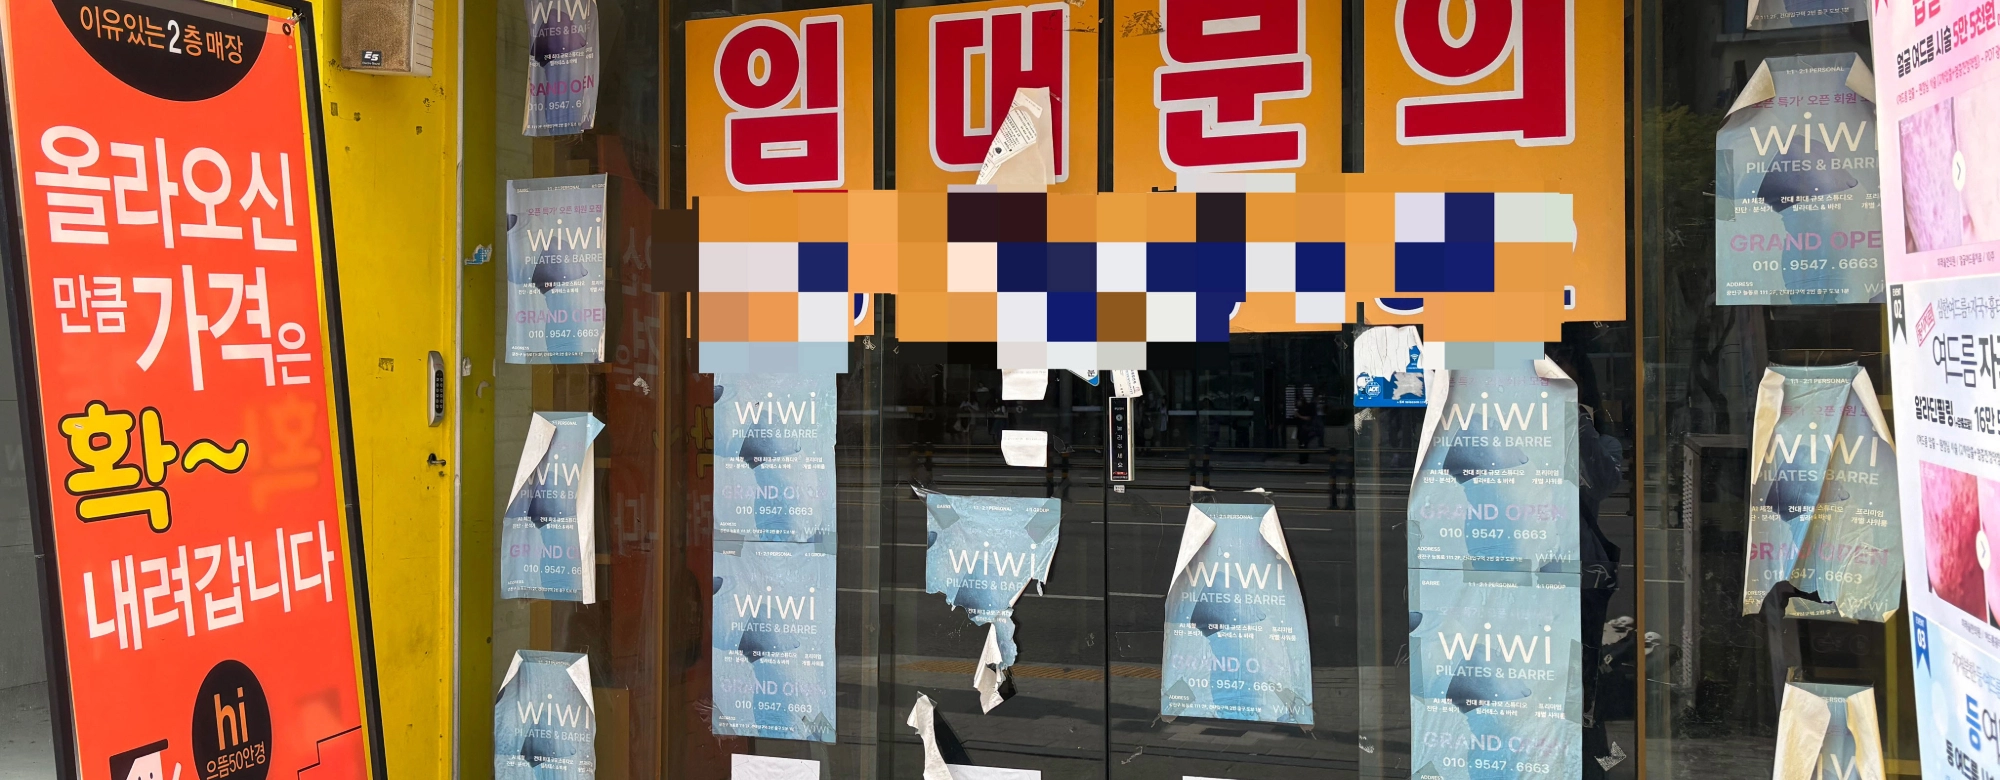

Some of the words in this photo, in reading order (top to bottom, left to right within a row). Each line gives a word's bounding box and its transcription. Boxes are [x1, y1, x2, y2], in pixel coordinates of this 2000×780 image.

[80, 5, 166, 49] 이유있는
[207, 33, 243, 65] 매장
[563, 26, 570, 35] &
[1896, 48, 1912, 78] 얼굴
[1911, 34, 1935, 69] 여드름
[1936, 25, 1952, 56] 시술
[1952, 15, 1968, 48] 5만
[1969, 0, 1997, 39] 5천원
[1809, 66, 1845, 74] PERSONAL
[549, 101, 570, 110] 9547
[1807, 94, 1830, 106] 오픈
[1834, 92, 1857, 104] 회원
[1746, 159, 1811, 174] PILATES
[1815, 159, 1826, 171] &
[35, 125, 297, 252] 올라오신
[1826, 194, 1853, 202] 스튜디오
[1734, 206, 1747, 214] 진단
[1753, 205, 1773, 213] 분석기
[527, 217, 601, 252] wiwi
[1730, 232, 1822, 252] GRAND
[525, 254, 562, 265] PILATES
[564, 254, 570, 263] &
[572, 253, 603, 263] BARRE
[1753, 260, 1779, 271] 010
[1790, 259, 1828, 271] 9547
[1838, 257, 1879, 270] 6663
[515, 309, 568, 324] GRAND
[1893, 299, 1903, 319] 02
[53, 275, 127, 333] 만큼
[133, 265, 312, 391] 가격은
[529, 330, 544, 339] 010
[550, 329, 571, 338] 9547
[577, 328, 599, 338] 6663
[1932, 333, 1978, 387] 여드름
[734, 391, 816, 425] wiwi
[1441, 391, 1548, 431] wiwi
[1974, 406, 1996, 435] 16만
[732, 429, 772, 438] PILATES
[775, 429, 782, 438] &
[784, 428, 818, 438] BARRE
[1433, 436, 1489, 447] PILATES
[1492, 436, 1501, 447] &
[1505, 436, 1552, 447] BARRE
[520, 490, 558, 499] PILATES
[560, 491, 566, 499] &
[736, 506, 753, 514] 010
[759, 506, 782, 515] 9547
[789, 507, 813, 516] 6663
[1788, 505, 1801, 513] 건대
[1855, 508, 1884, 517] 프리미엄
[1439, 527, 1462, 538] 010
[1472, 528, 1504, 539] 9547
[1513, 529, 1547, 540] 6663
[948, 540, 1037, 578] wiwi
[1535, 550, 1571, 563] wiwi
[1817, 542, 1889, 566] OPEN
[524, 564, 538, 573] 010
[544, 565, 566, 574] 9547
[1185, 551, 1283, 590] wiwi
[83, 520, 335, 650] 내려갑니다
[946, 578, 988, 590] PILATES
[990, 581, 997, 590] &
[1825, 570, 1863, 585] 6663
[733, 585, 815, 620] wiwi
[1181, 591, 1231, 603] PILATES
[1234, 594, 1241, 604] &
[1245, 594, 1286, 606] BARRE
[731, 621, 772, 633] PILATES
[774, 623, 781, 633] &
[783, 624, 817, 634] BARRE
[1438, 622, 1551, 665] wiwi
[1917, 628, 1927, 650] 03
[1435, 665, 1491, 677] PILATES
[1495, 667, 1504, 678] &
[1508, 668, 1555, 681] BARRE
[1188, 678, 1208, 688] 010
[1216, 680, 1245, 690] 9547
[1253, 681, 1283, 692] 6663
[735, 700, 751, 709] 010
[758, 701, 781, 711] 9547
[788, 704, 812, 713] 6663
[1272, 702, 1305, 715] wiwi
[1538, 703, 1562, 711] 프리미엄
[213, 687, 249, 751] hi
[554, 731, 560, 739] &
[562, 731, 591, 742] BARRE
[206, 741, 266, 780] 으뜸50안경
[1442, 757, 1465, 767] 010
[1475, 759, 1507, 770] 9547
[1516, 762, 1550, 774] 6663
